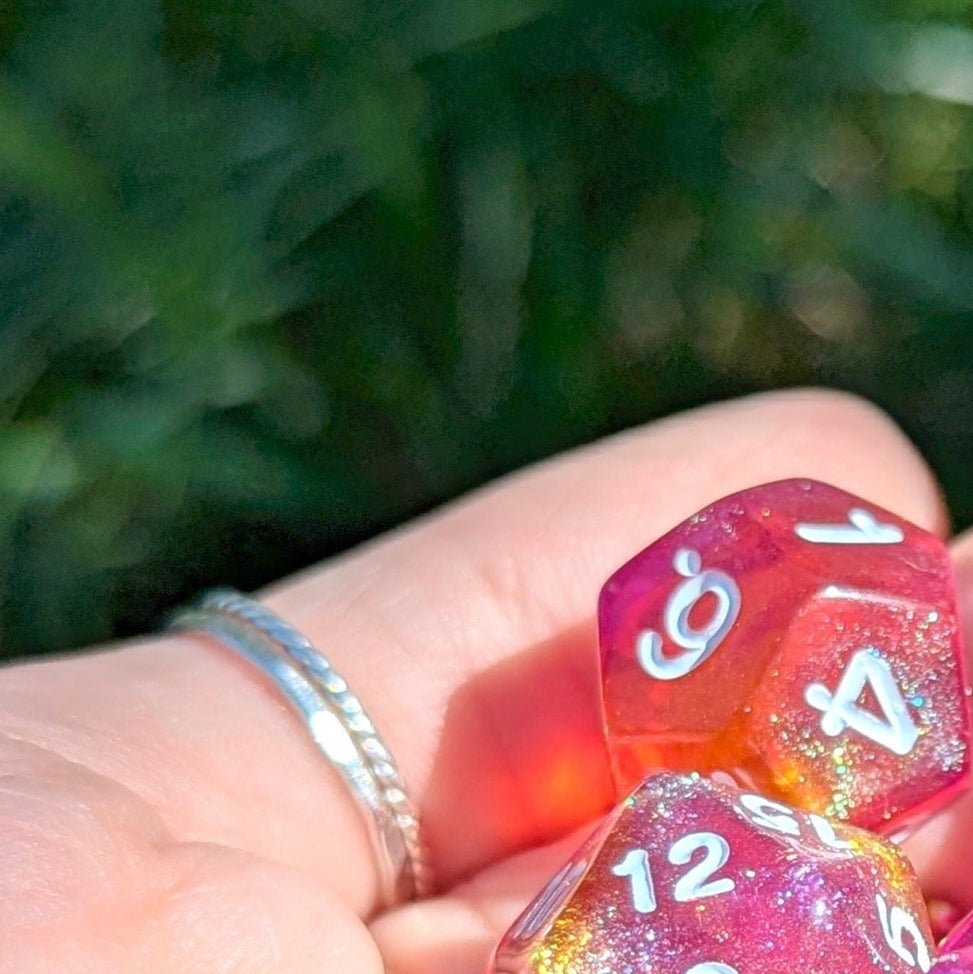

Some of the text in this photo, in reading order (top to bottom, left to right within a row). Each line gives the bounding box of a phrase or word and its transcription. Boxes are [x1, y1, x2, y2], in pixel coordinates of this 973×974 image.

[794, 508, 904, 544] 1
[804, 648, 919, 755] 4
[611, 832, 735, 914] 12
